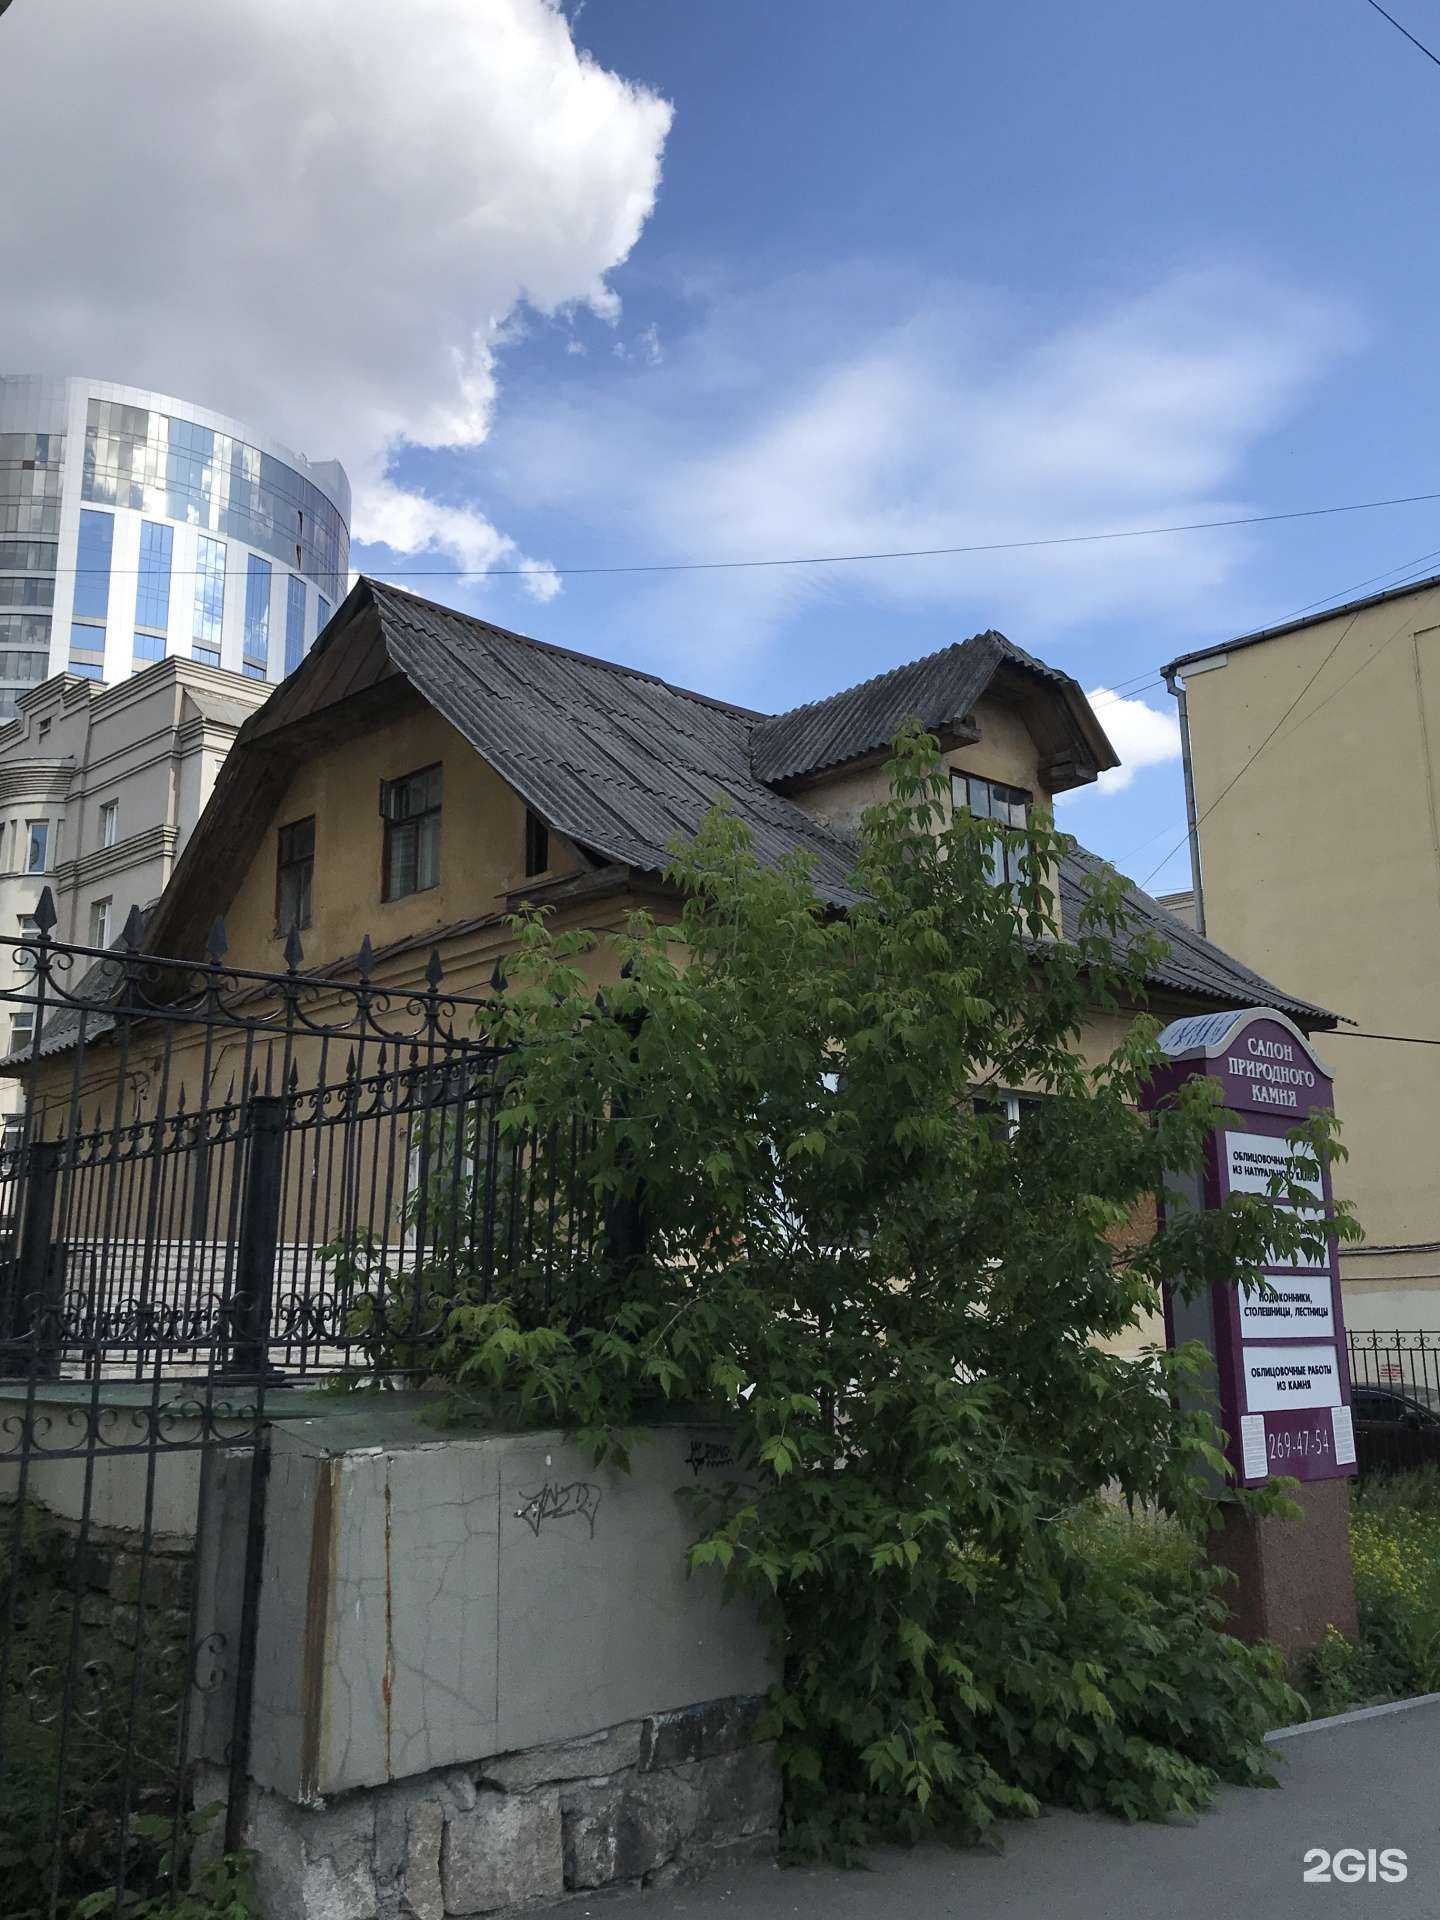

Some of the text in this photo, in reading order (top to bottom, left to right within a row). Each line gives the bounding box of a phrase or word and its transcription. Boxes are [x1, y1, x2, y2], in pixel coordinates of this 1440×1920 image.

[1247, 1037, 1294, 1062] САЛОН
[1228, 1056, 1315, 1088] ПРИРОДНОГО
[1251, 1084, 1298, 1107] КАМНЯ
[1232, 1165, 1243, 1175] ИЗ
[1244, 1306, 1328, 1318] СТОЛЕШНИЦЫ, ЛЕСТНИЦЫ
[1251, 1365, 1332, 1378] ОБЛИЦОВОЧНЫЕ РАБОТЫ
[1276, 1379, 1311, 1391] ИЗ КАМНЯ
[1268, 1428, 1330, 1460] 269-47-54
